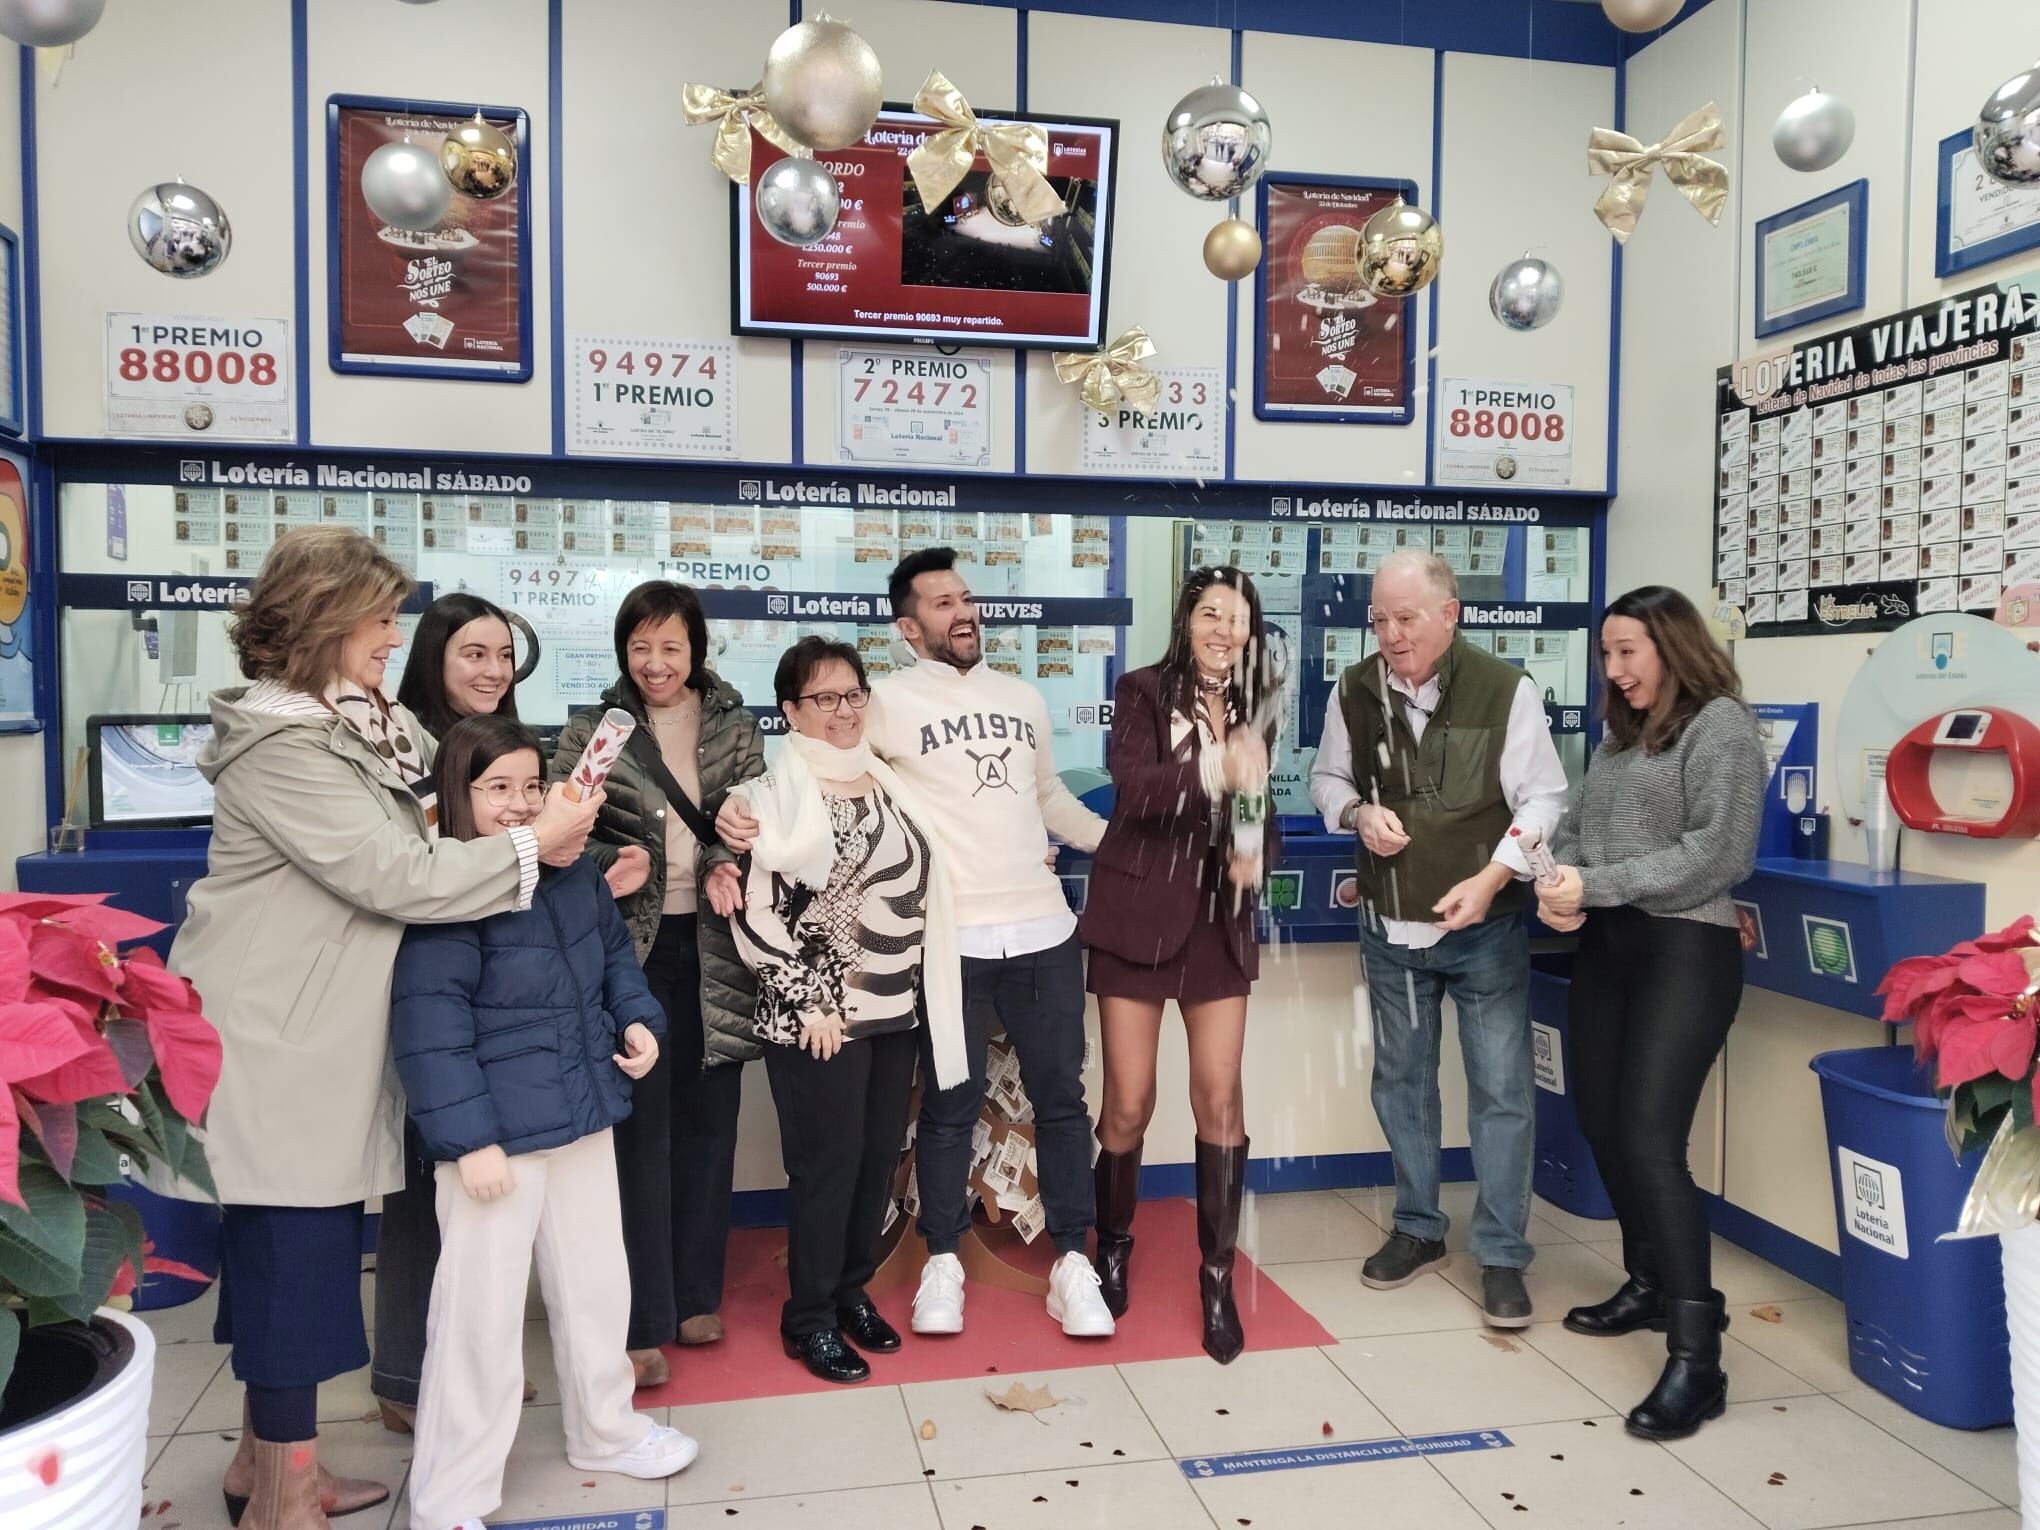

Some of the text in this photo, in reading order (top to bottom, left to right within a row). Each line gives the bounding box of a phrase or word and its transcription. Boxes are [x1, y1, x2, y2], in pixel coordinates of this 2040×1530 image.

[405, 260, 452, 284] SORTEO
[424, 256, 439, 267] EL
[798, 259, 857, 271] Tercer premio
[815, 272, 839, 281] 90693
[409, 281, 452, 302] NOS UNE
[806, 283, 848, 293] 500.000 €
[854, 310, 1004, 326] Tercer premio 90693 muy repartido.
[1318, 318, 1356, 339] SORTEO
[153, 325, 263, 348] PREMIO
[1322, 336, 1356, 355] NOS UNE
[1740, 284, 2025, 399] LOTERIA VIAJERA
[119, 347, 277, 386] 88008
[589, 349, 717, 380] 94974
[892, 360, 968, 379] PREMIO
[1793, 387, 1808, 407] de
[1808, 374, 1853, 402] Navidad
[1855, 371, 1871, 389] de
[1872, 362, 1905, 384] todas
[1908, 358, 1927, 377] las
[1928, 339, 1999, 376] provincias
[616, 383, 714, 408] PREMIO
[853, 378, 977, 409] 72472
[1476, 390, 1555, 410] PREMIO
[1450, 408, 1564, 442] 88008
[916, 433, 943, 441] Nacional
[212, 461, 531, 493] Lotería Nacional SÁBADO
[767, 481, 956, 507] Lotería Nacional
[1296, 497, 1540, 522] Lotería Nacional SÁBADO
[676, 562, 771, 581] PREMIO
[160, 581, 251, 602] Lotería
[528, 592, 597, 606] PREMIO
[793, 595, 872, 616] Lotería
[1464, 606, 1542, 624] Nacional
[986, 760, 1002, 781] A
[1855, 1219, 1895, 1246] Nacional
[1223, 1439, 1472, 1471] MANTENGA LA DISTANCIA DE SEGURIDAD
